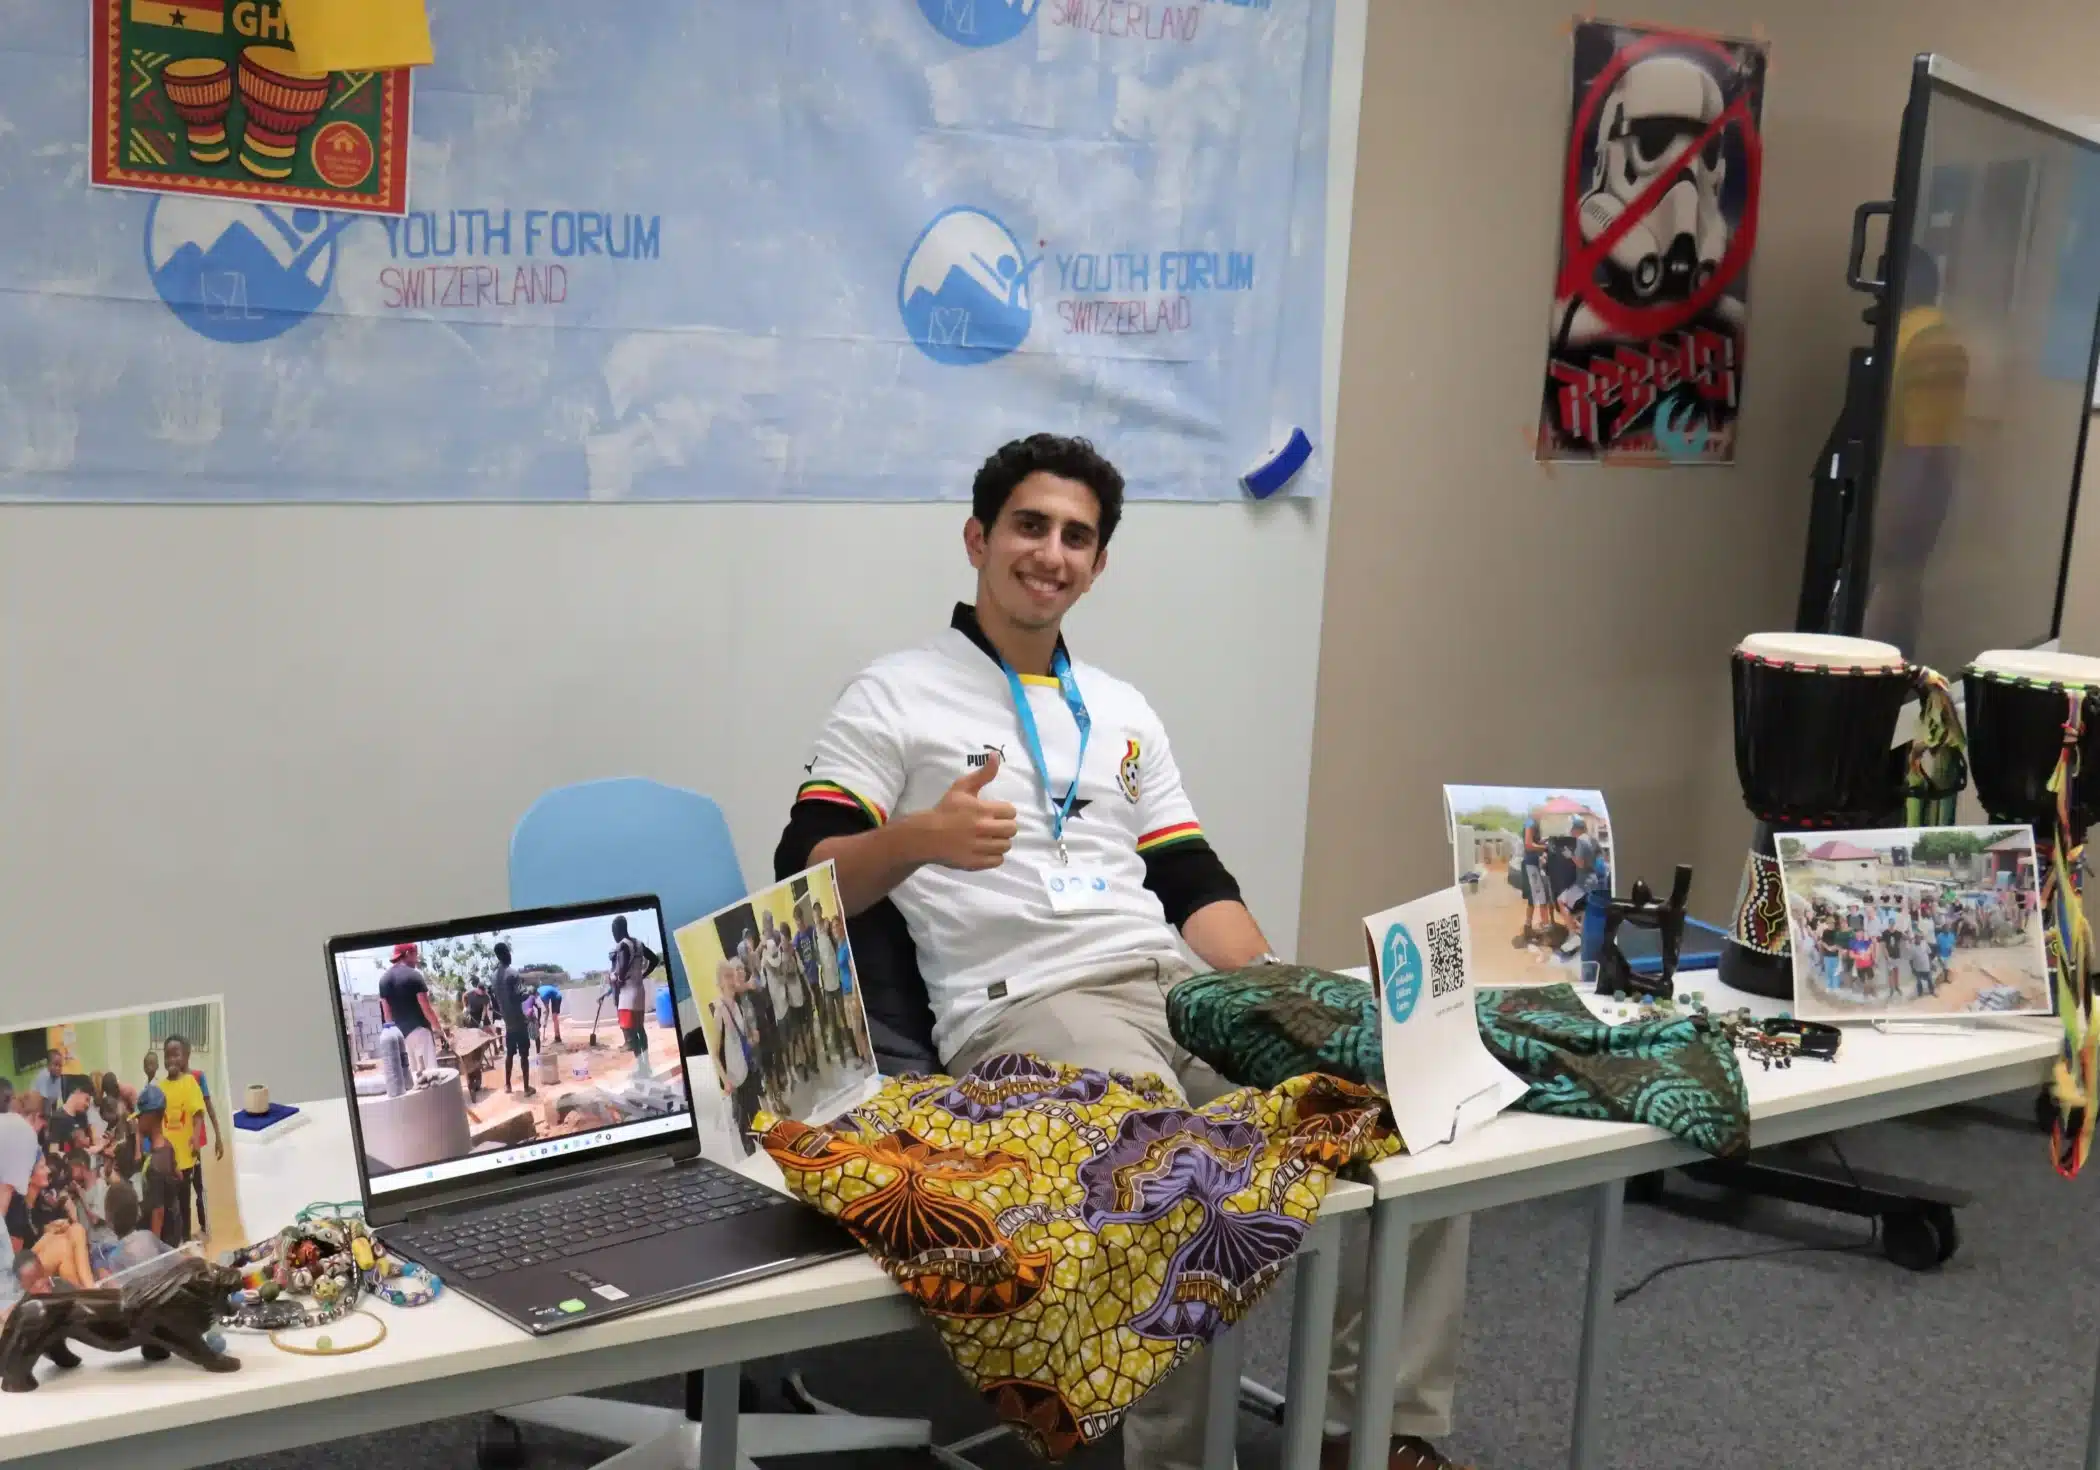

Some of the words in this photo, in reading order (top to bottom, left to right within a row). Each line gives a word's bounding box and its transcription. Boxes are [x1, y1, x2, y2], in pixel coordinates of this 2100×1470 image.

[232, 1, 292, 41] GH
[379, 208, 511, 259] YOUTH
[524, 210, 661, 260] FORUM
[379, 264, 568, 309] SWITZERLAND
[1056, 253, 1149, 292] YOUTH
[1160, 251, 1255, 291] FORUM
[1057, 297, 1192, 336] SWITZERLAND
